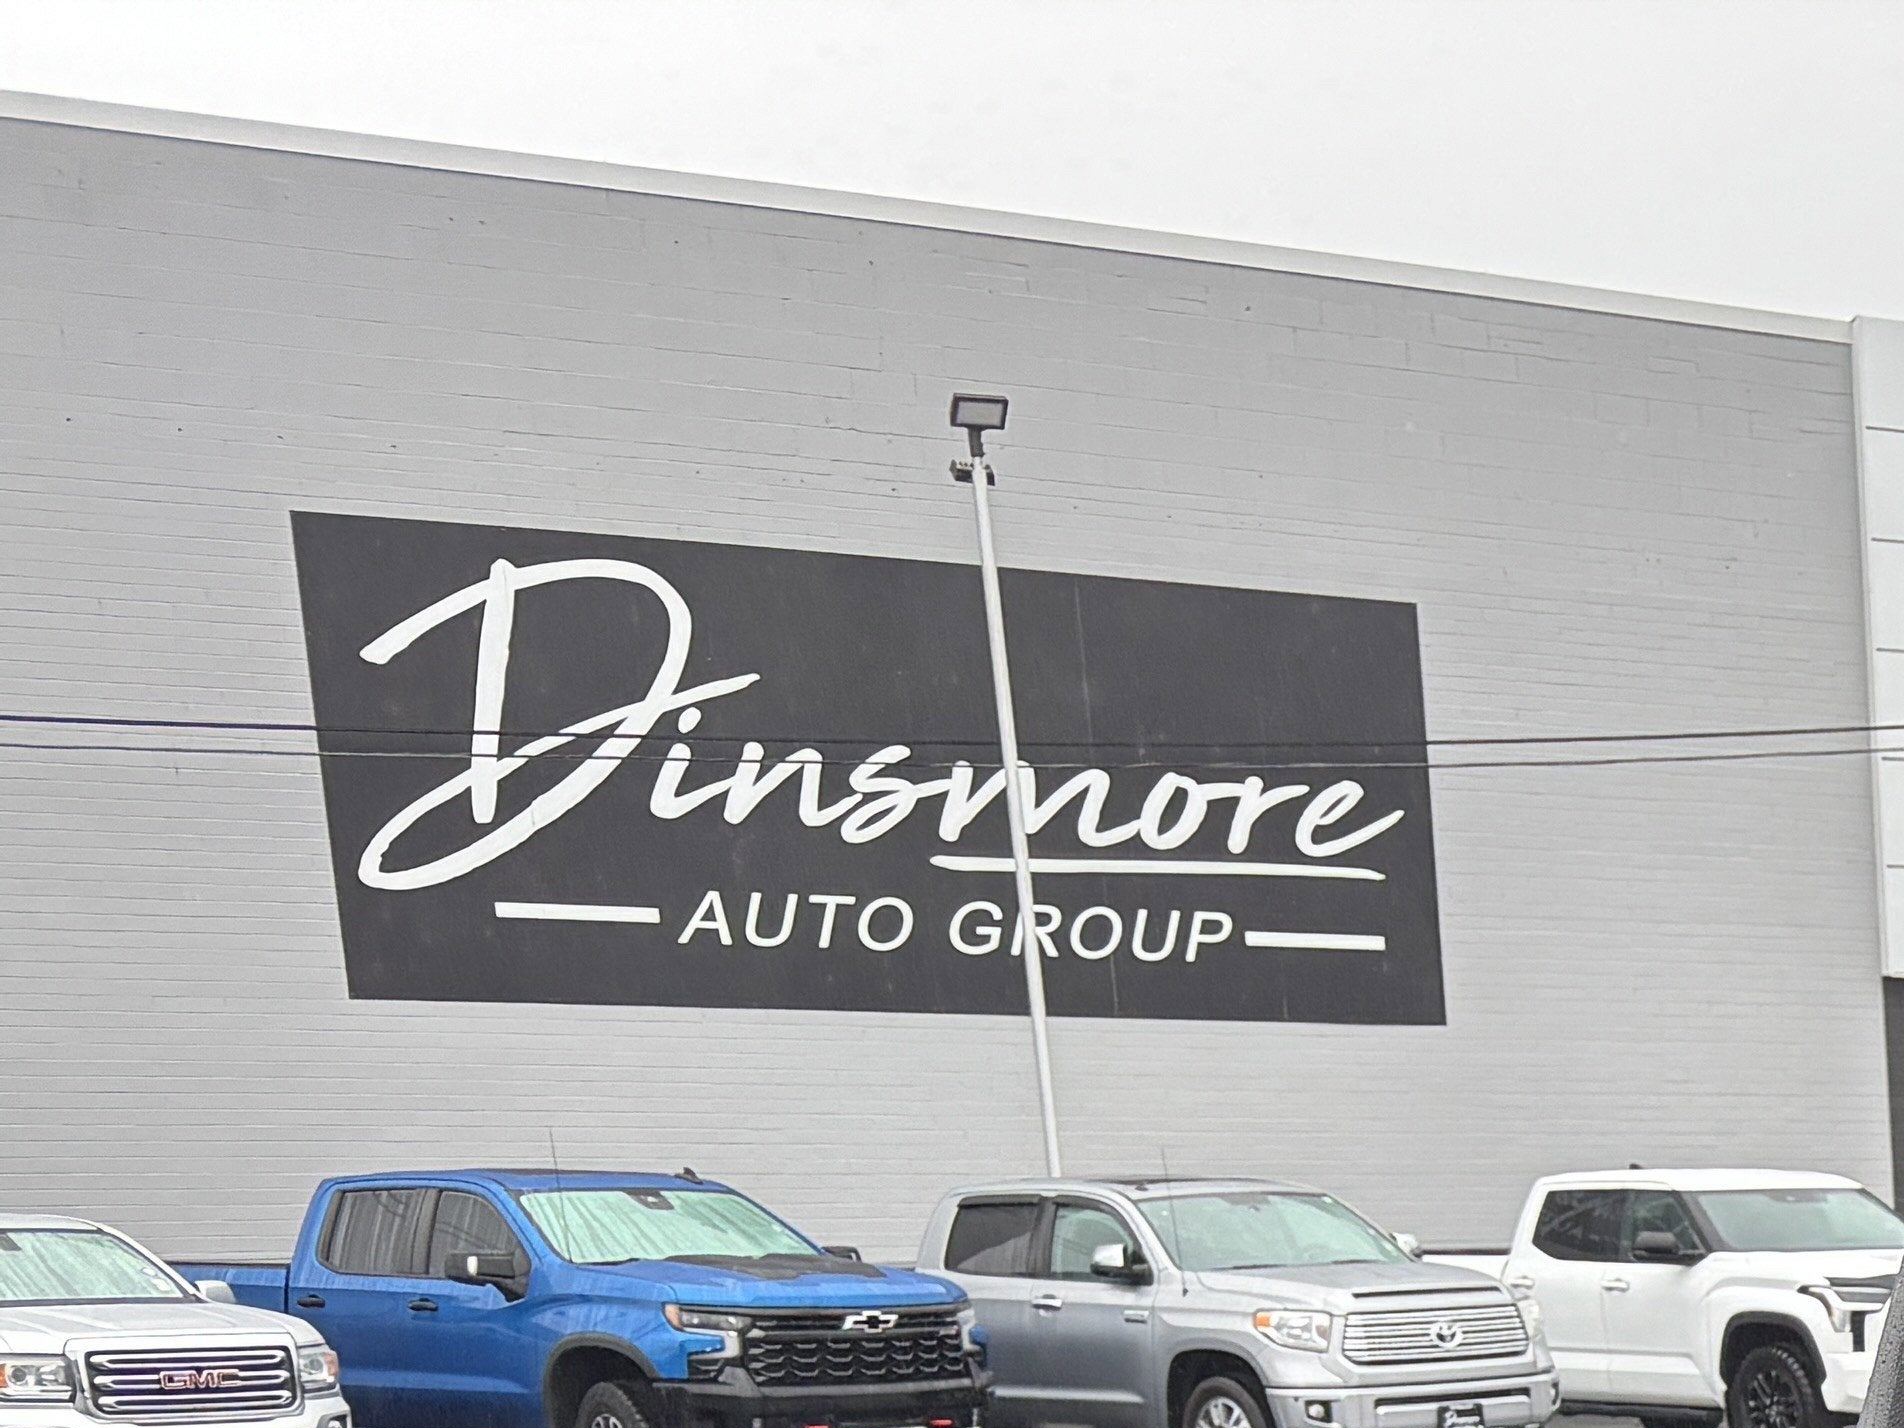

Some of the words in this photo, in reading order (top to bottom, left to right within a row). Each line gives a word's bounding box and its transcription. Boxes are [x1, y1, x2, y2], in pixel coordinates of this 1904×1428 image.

[359, 558, 1404, 890] Dinsmore
[678, 889, 914, 954] AUTO
[948, 904, 1234, 964] GROUP
[159, 1368, 240, 1390] GMC
